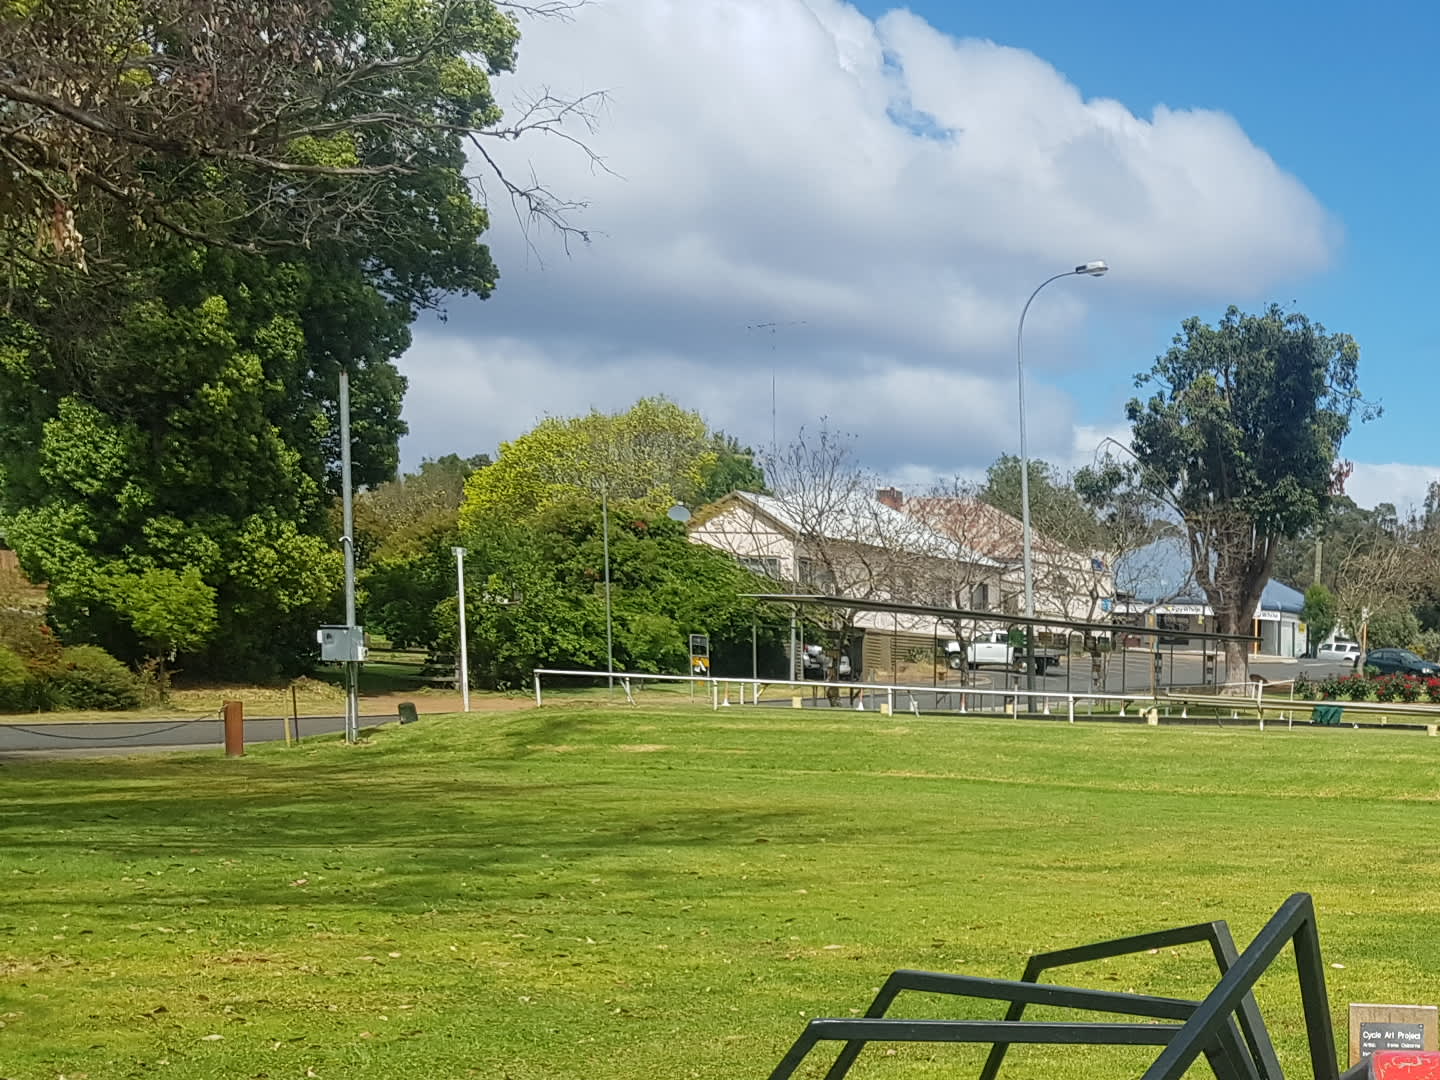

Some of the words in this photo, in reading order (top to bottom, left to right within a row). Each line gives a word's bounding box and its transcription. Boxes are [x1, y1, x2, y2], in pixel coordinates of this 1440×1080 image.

[1362, 1031, 1382, 1040] Cycle
[1384, 1031, 1395, 1039] Art
[1397, 1031, 1421, 1041] Project
